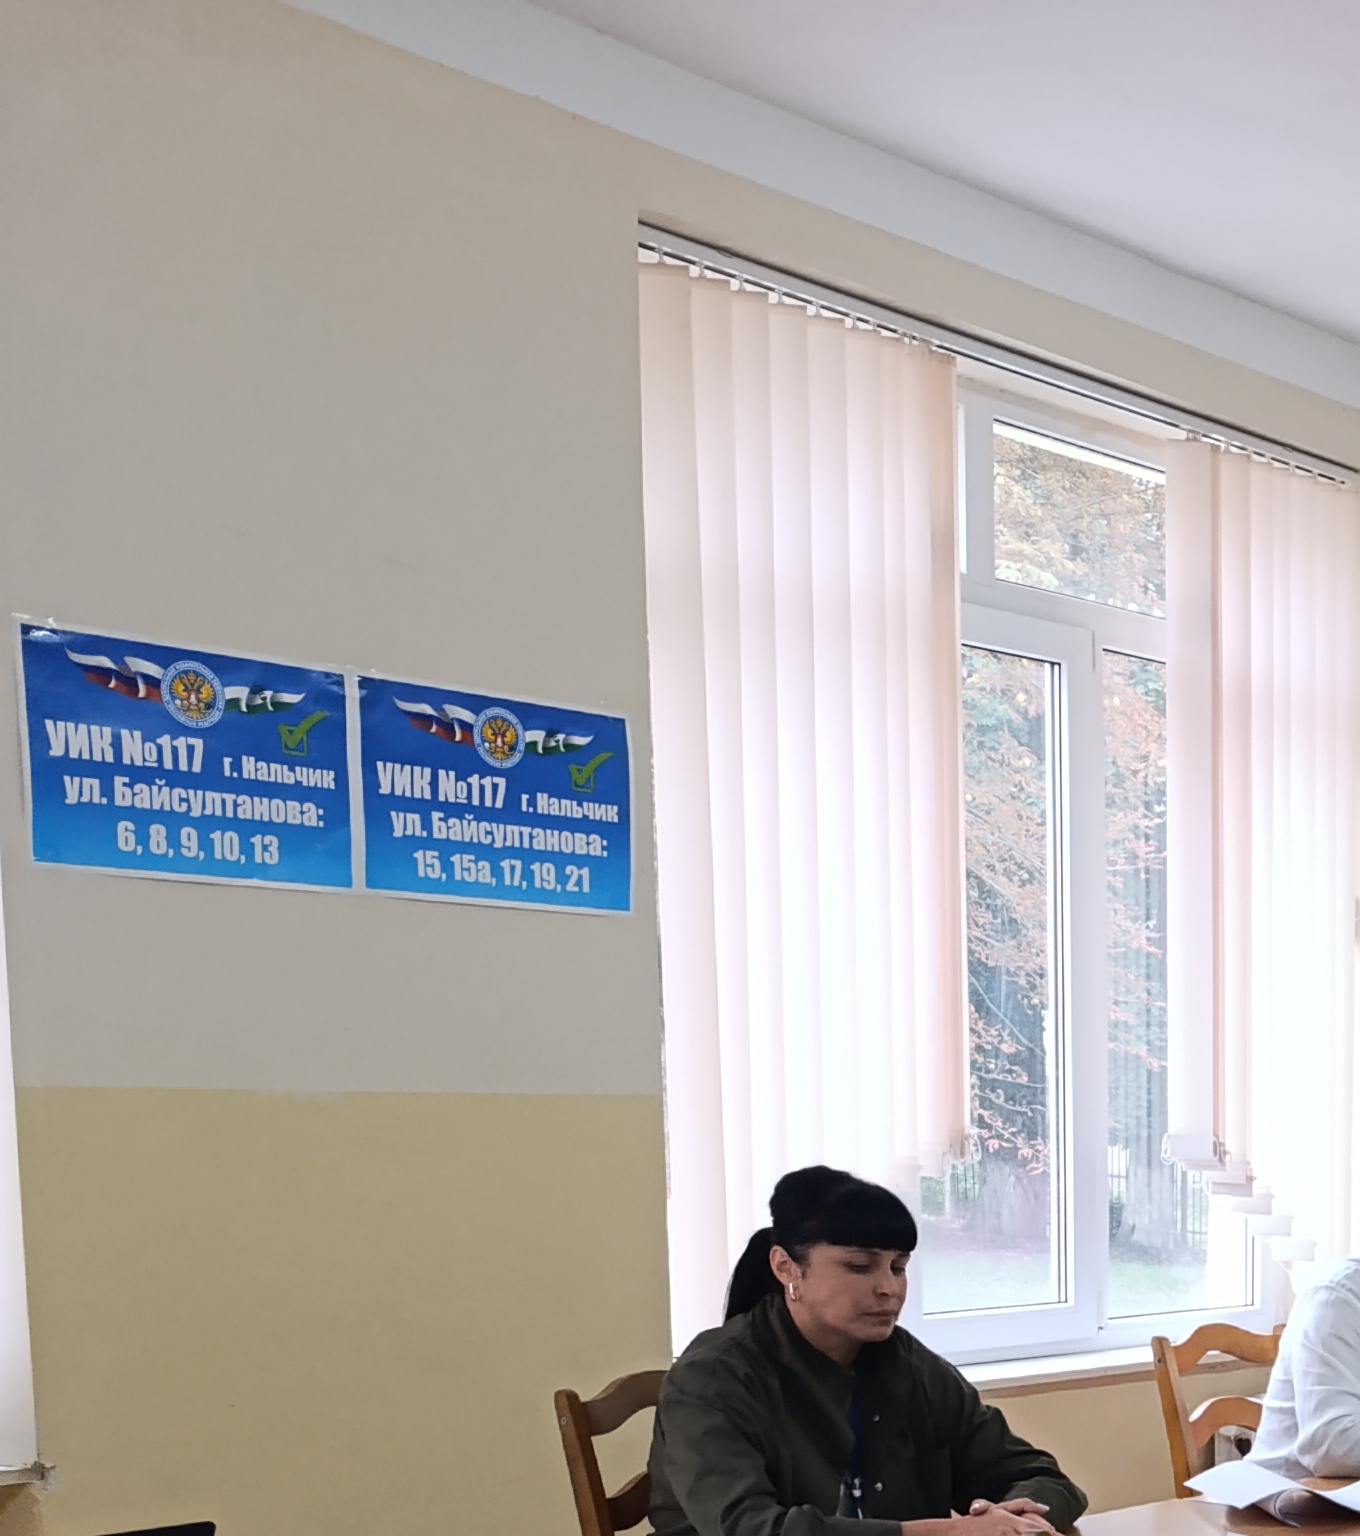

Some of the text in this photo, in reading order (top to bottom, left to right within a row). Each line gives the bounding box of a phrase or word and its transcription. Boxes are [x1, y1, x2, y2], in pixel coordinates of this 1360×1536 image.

[44, 719, 336, 789] УИК №117 г. Нальчик
[63, 775, 325, 828] ул. Байсултанова:
[376, 760, 618, 823] УИК №117 г. Нальчик
[117, 820, 279, 865] 6, 8, 9, 10, 13
[390, 811, 608, 857] ул. Байсултанова:
[413, 849, 590, 894] 15, 15а, 17, 19, 21
